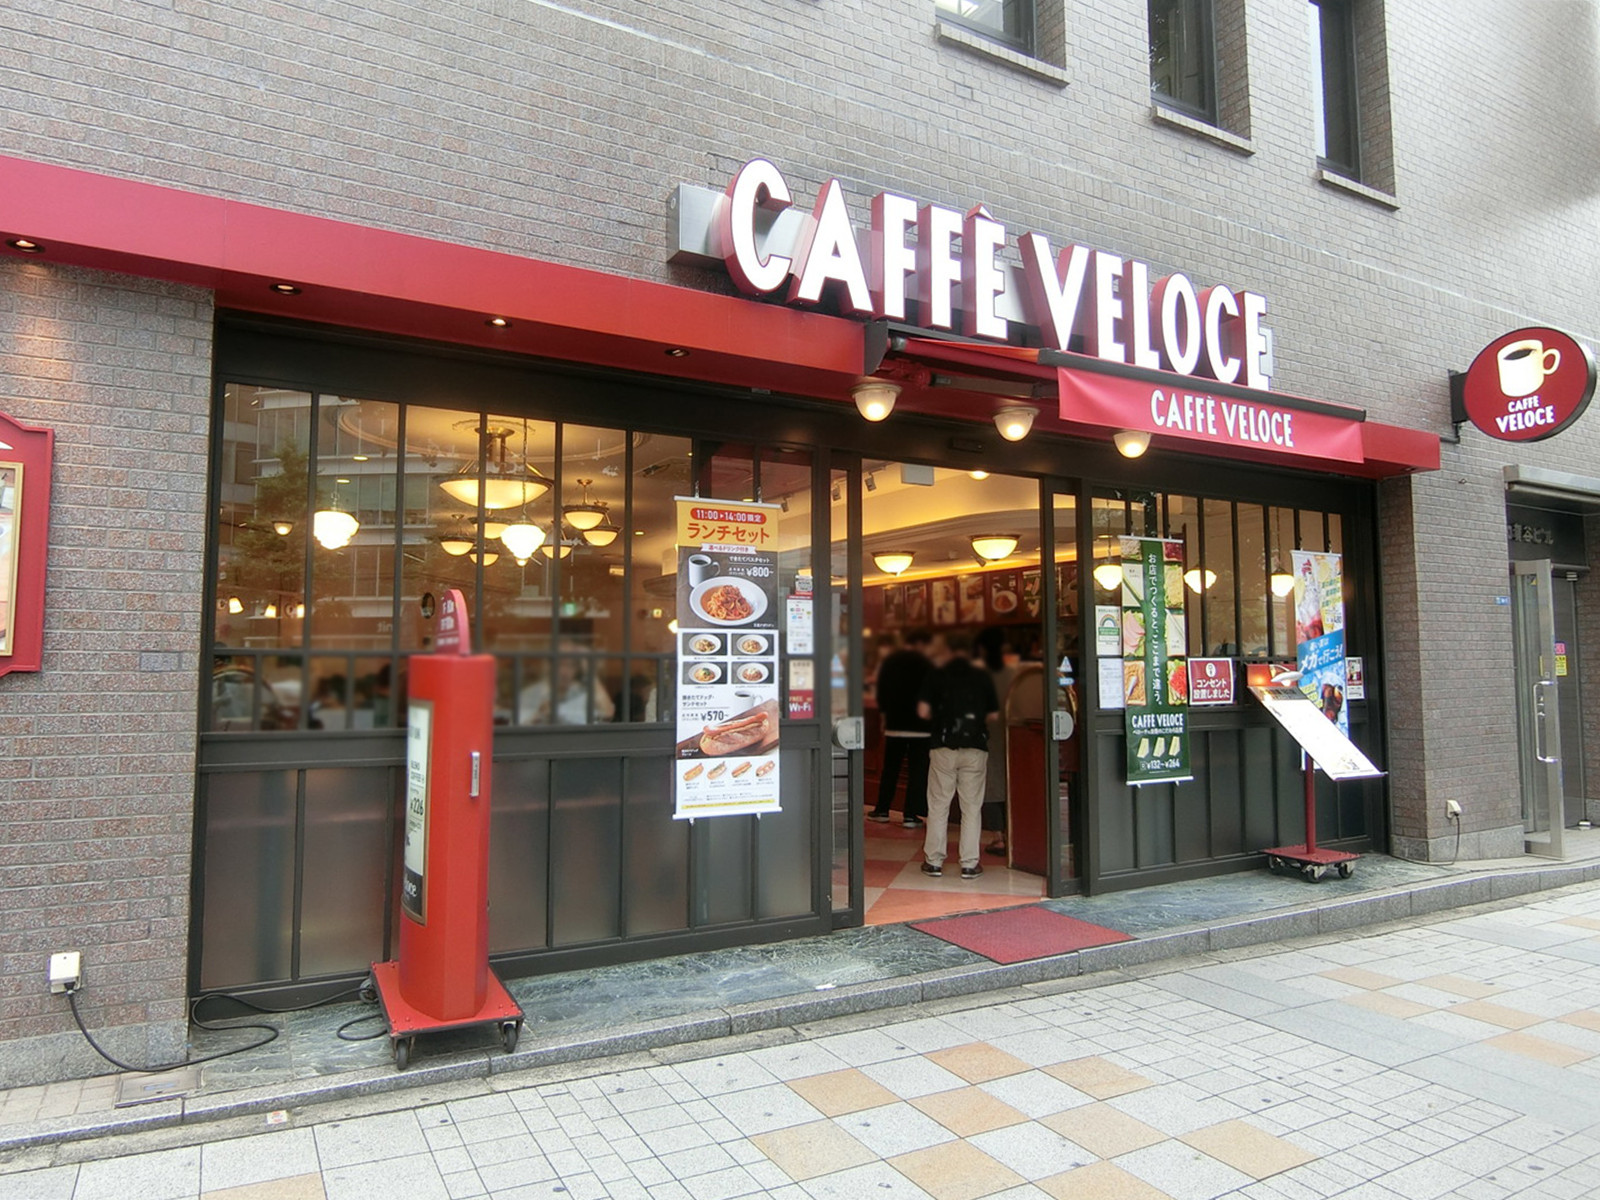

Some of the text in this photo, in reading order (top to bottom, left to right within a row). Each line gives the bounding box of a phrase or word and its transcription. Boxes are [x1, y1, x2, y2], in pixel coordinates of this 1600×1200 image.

[1020, 230, 1271, 391] VELOCE
[1221, 401, 1294, 449] VELOCE
[1495, 405, 1555, 434] VELOCE
[696, 509, 718, 520] 11:00
[687, 523, 770, 544] ランチセット
[1196, 679, 1227, 688] コンセント
[1157, 713, 1184, 727] VELOCE
